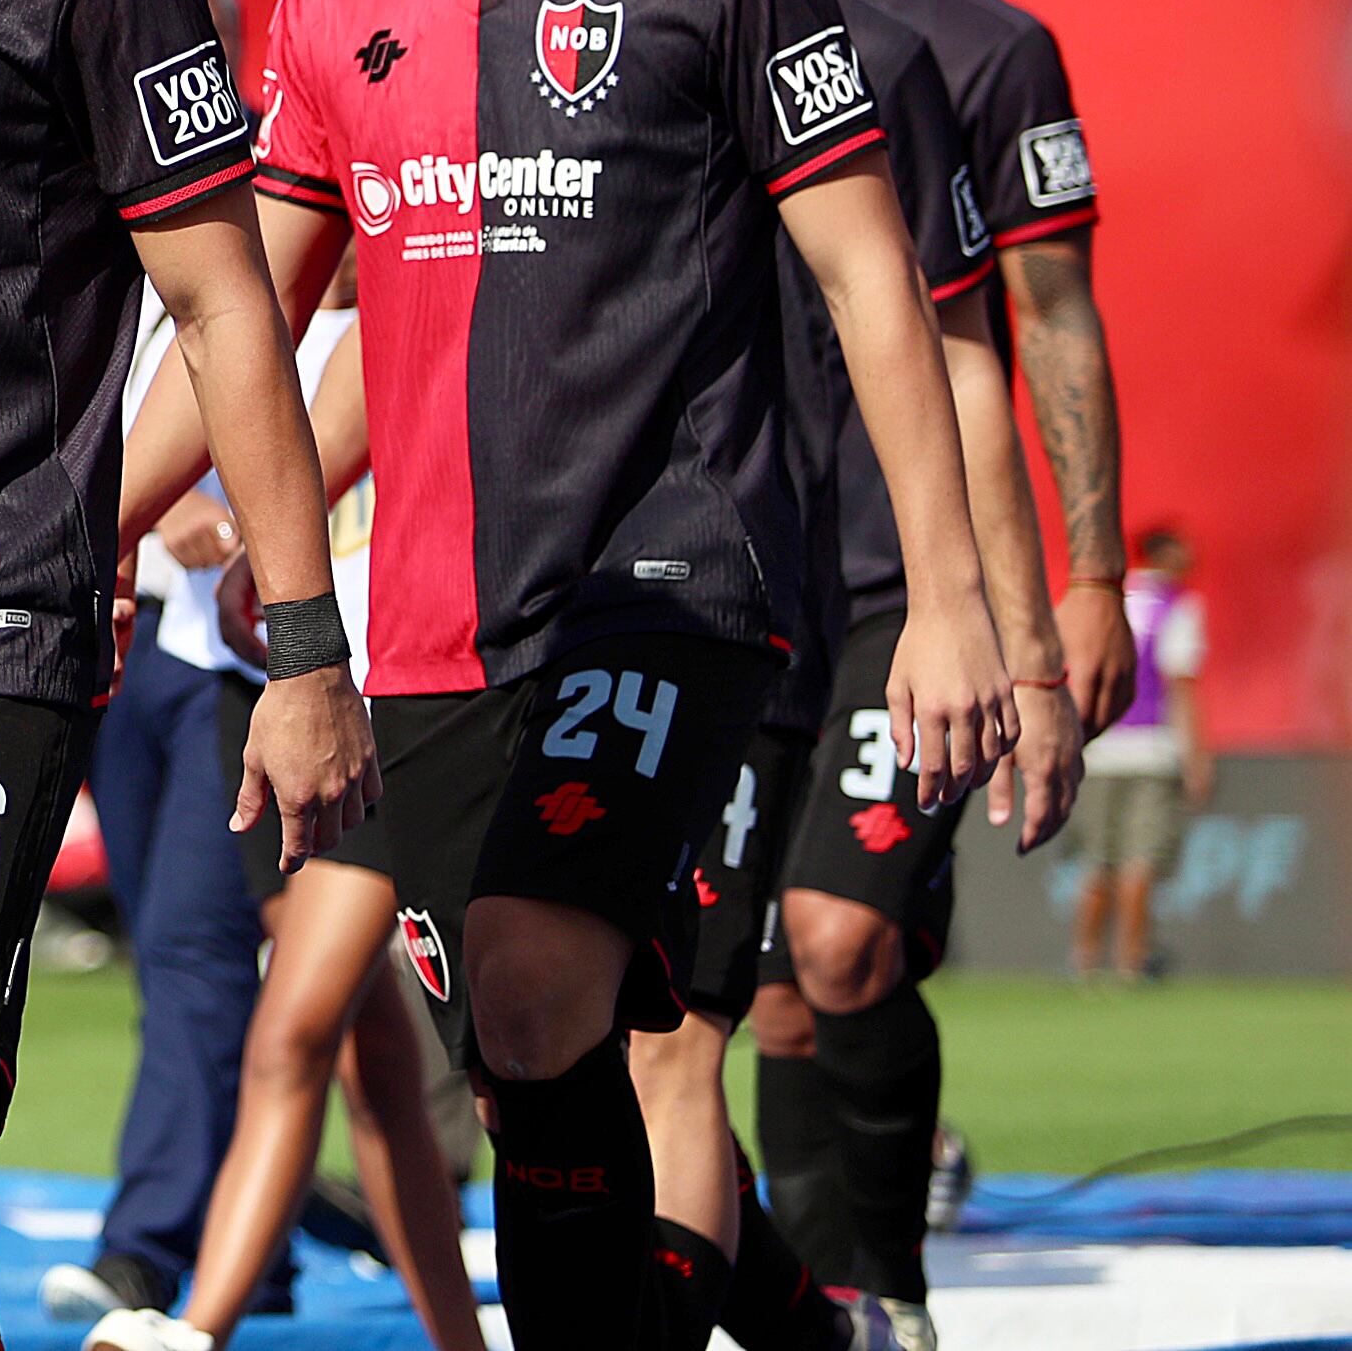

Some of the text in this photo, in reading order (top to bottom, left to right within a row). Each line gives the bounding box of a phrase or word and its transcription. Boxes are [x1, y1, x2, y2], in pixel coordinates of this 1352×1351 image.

[549, 25, 607, 52] NOB
[503, 198, 594, 219] ONLINE
[6, 614, 28, 623] TECH
[541, 668, 679, 779] 24
[840, 708, 923, 802] 3
